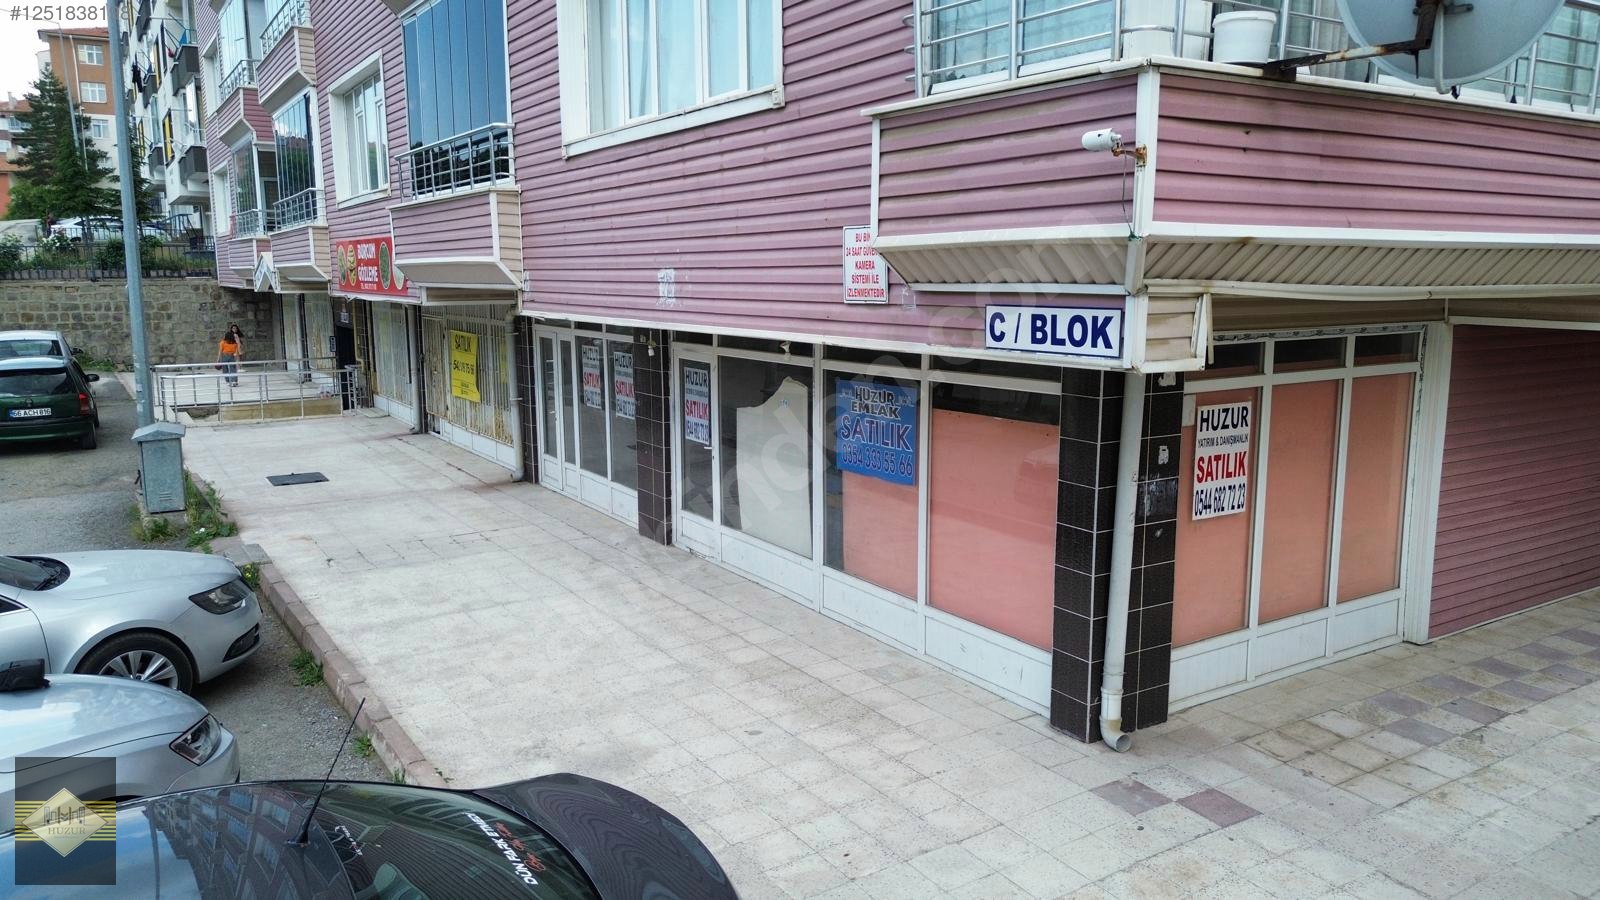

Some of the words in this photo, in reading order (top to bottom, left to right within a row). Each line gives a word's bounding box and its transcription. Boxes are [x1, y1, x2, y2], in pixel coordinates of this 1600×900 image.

[855, 233, 863, 242] BU
[846, 247, 852, 257] 24
[851, 246, 863, 256] SAAT
[855, 260, 875, 270] KAMERA
[989, 311, 1006, 343] C
[1030, 313, 1114, 350] BLOK
[615, 379, 636, 399] SATILIK
[685, 369, 708, 388] HUZUR
[855, 386, 895, 406] HUZUR
[685, 399, 709, 421] SATILIK
[850, 399, 902, 420] EMLAK
[1199, 406, 1249, 433] HUZUR
[841, 415, 913, 452] SATILIK
[842, 444, 865, 467] 0354
[864, 447, 883, 471] 333
[883, 451, 896, 474] 55
[898, 454, 914, 477] 66
[1196, 451, 1248, 484] SATILIK
[1194, 488, 1213, 516] 0544
[1213, 486, 1227, 513] 682
[1227, 484, 1237, 511] 72
[1236, 482, 1246, 510] 23
[512, 862, 538, 885] DÜN
